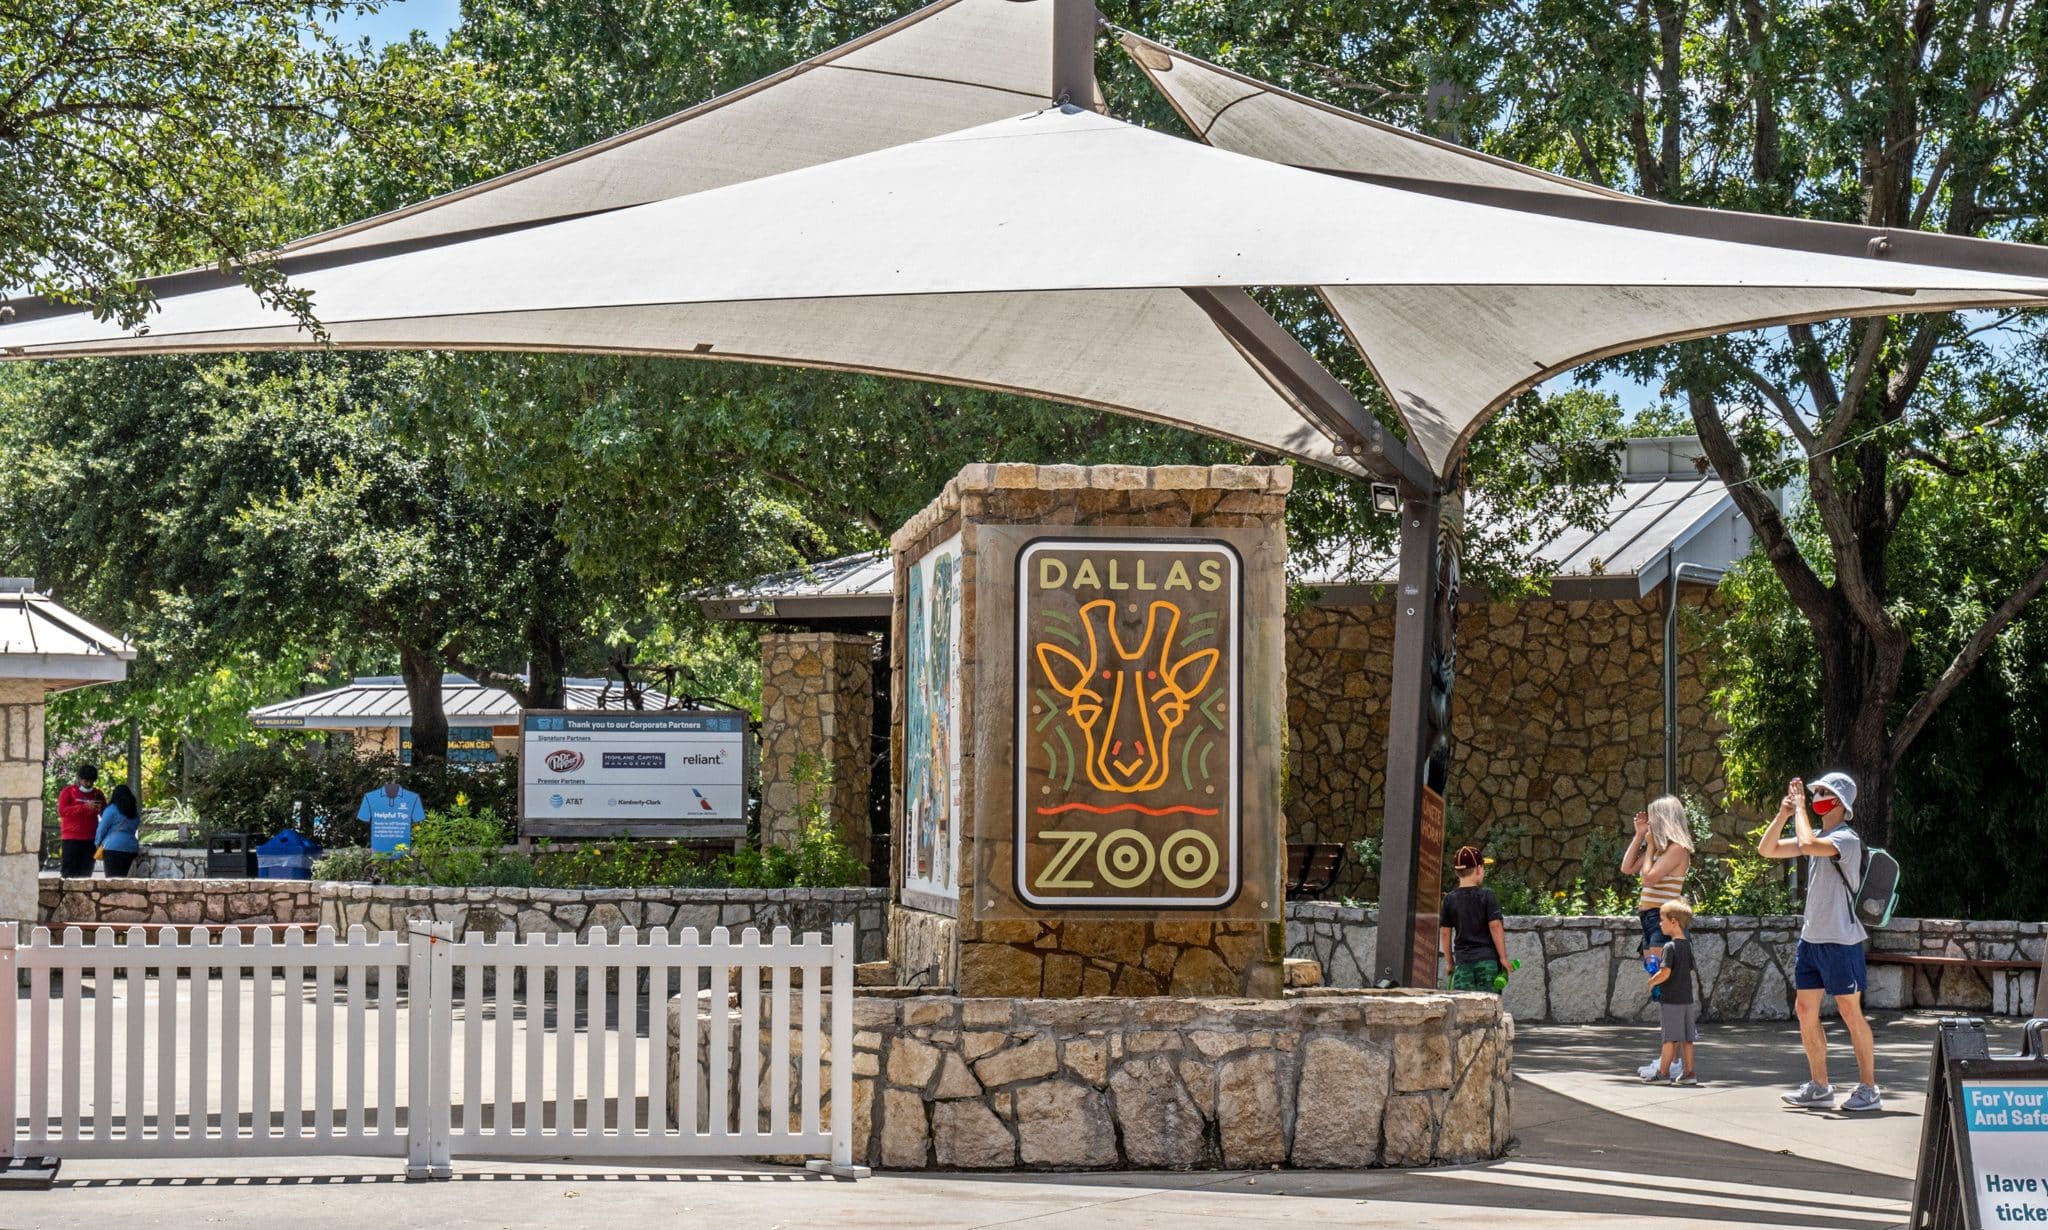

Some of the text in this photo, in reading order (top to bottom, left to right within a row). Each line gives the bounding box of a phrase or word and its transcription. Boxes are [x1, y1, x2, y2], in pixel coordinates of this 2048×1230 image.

[1039, 558, 1222, 591] DALLAS
[567, 721, 591, 729] Thank
[592, 723, 606, 731] you
[607, 721, 615, 729] to
[630, 721, 667, 731] Corporate
[668, 721, 701, 729] Partners
[683, 754, 721, 765] reliant
[1034, 828, 1219, 889] ZOO
[1972, 1091, 1999, 1107] For
[2003, 1091, 2043, 1107] Your
[1975, 1110, 2008, 1125] And
[1986, 1175, 2037, 1192] Have
[1996, 1203, 2048, 1221] ticke
